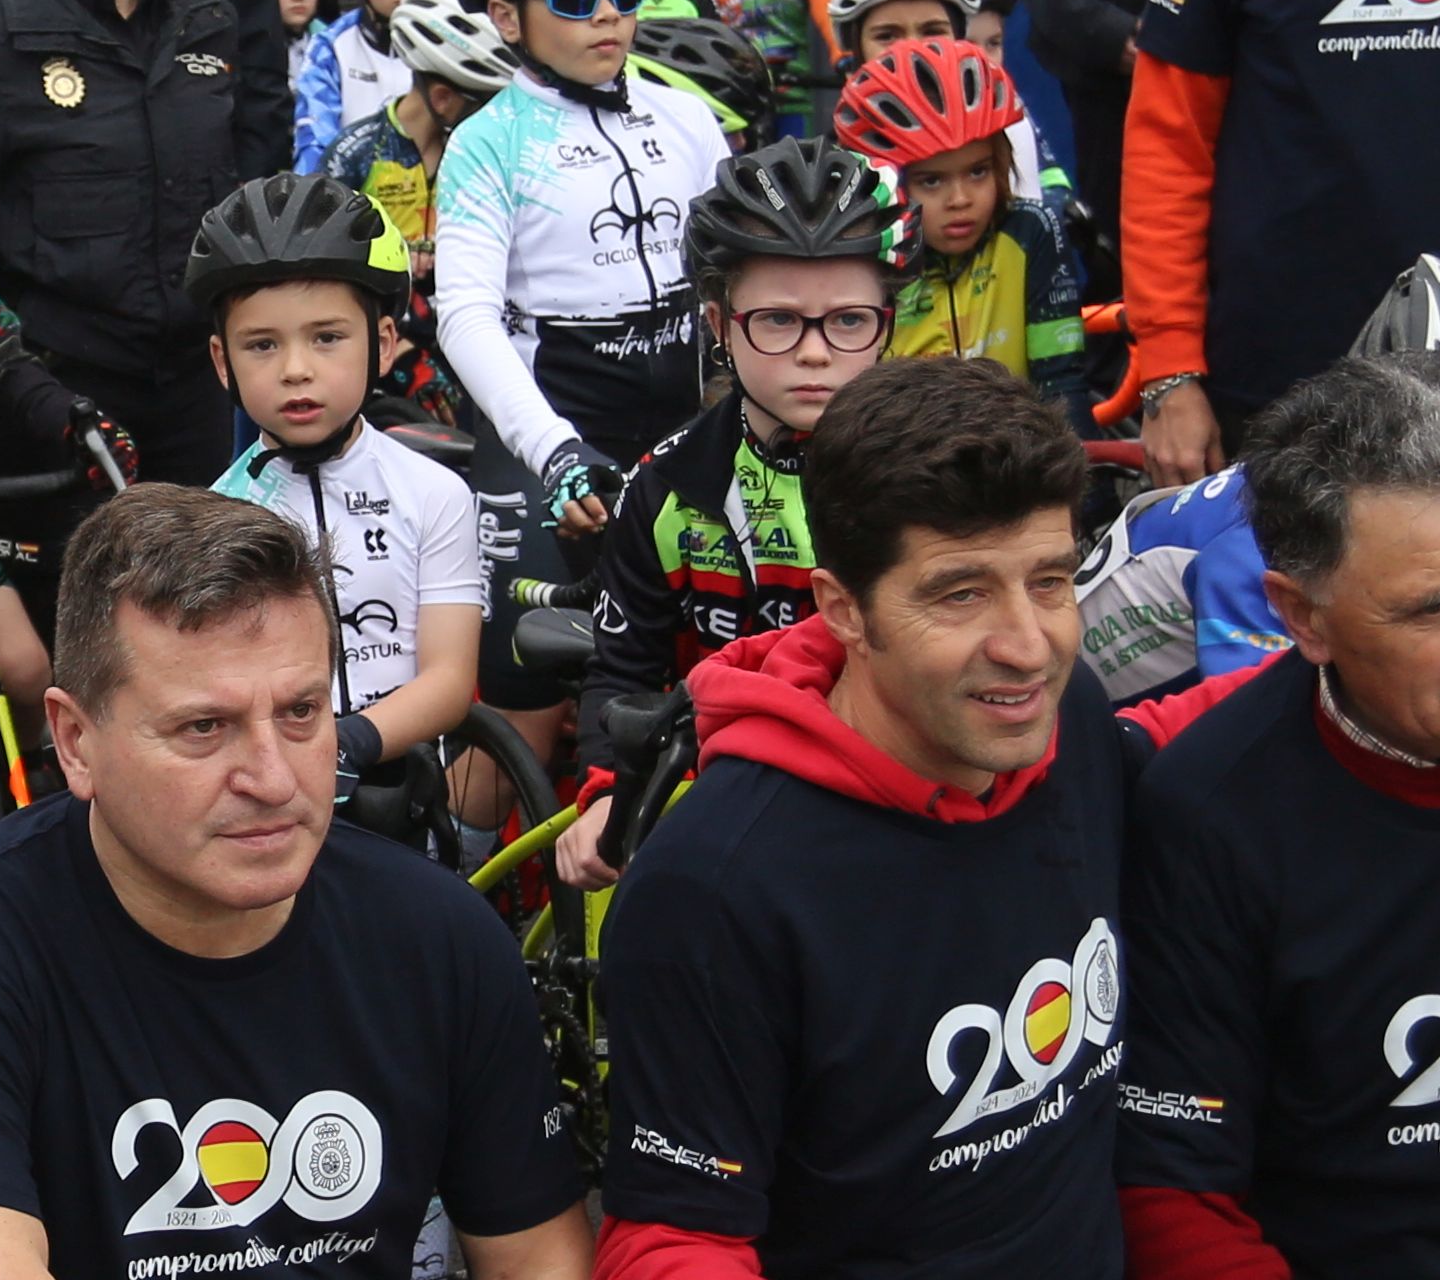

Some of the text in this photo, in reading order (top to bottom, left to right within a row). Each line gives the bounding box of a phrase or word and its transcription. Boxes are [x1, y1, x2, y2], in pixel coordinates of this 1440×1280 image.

[925, 917, 1122, 1139] 200
[1011, 1081, 1038, 1102] 2024
[542, 1107, 562, 1138] 182
[110, 1089, 383, 1237] 200
[165, 1211, 198, 1228] 1824
[283, 1226, 380, 1269] contigo
